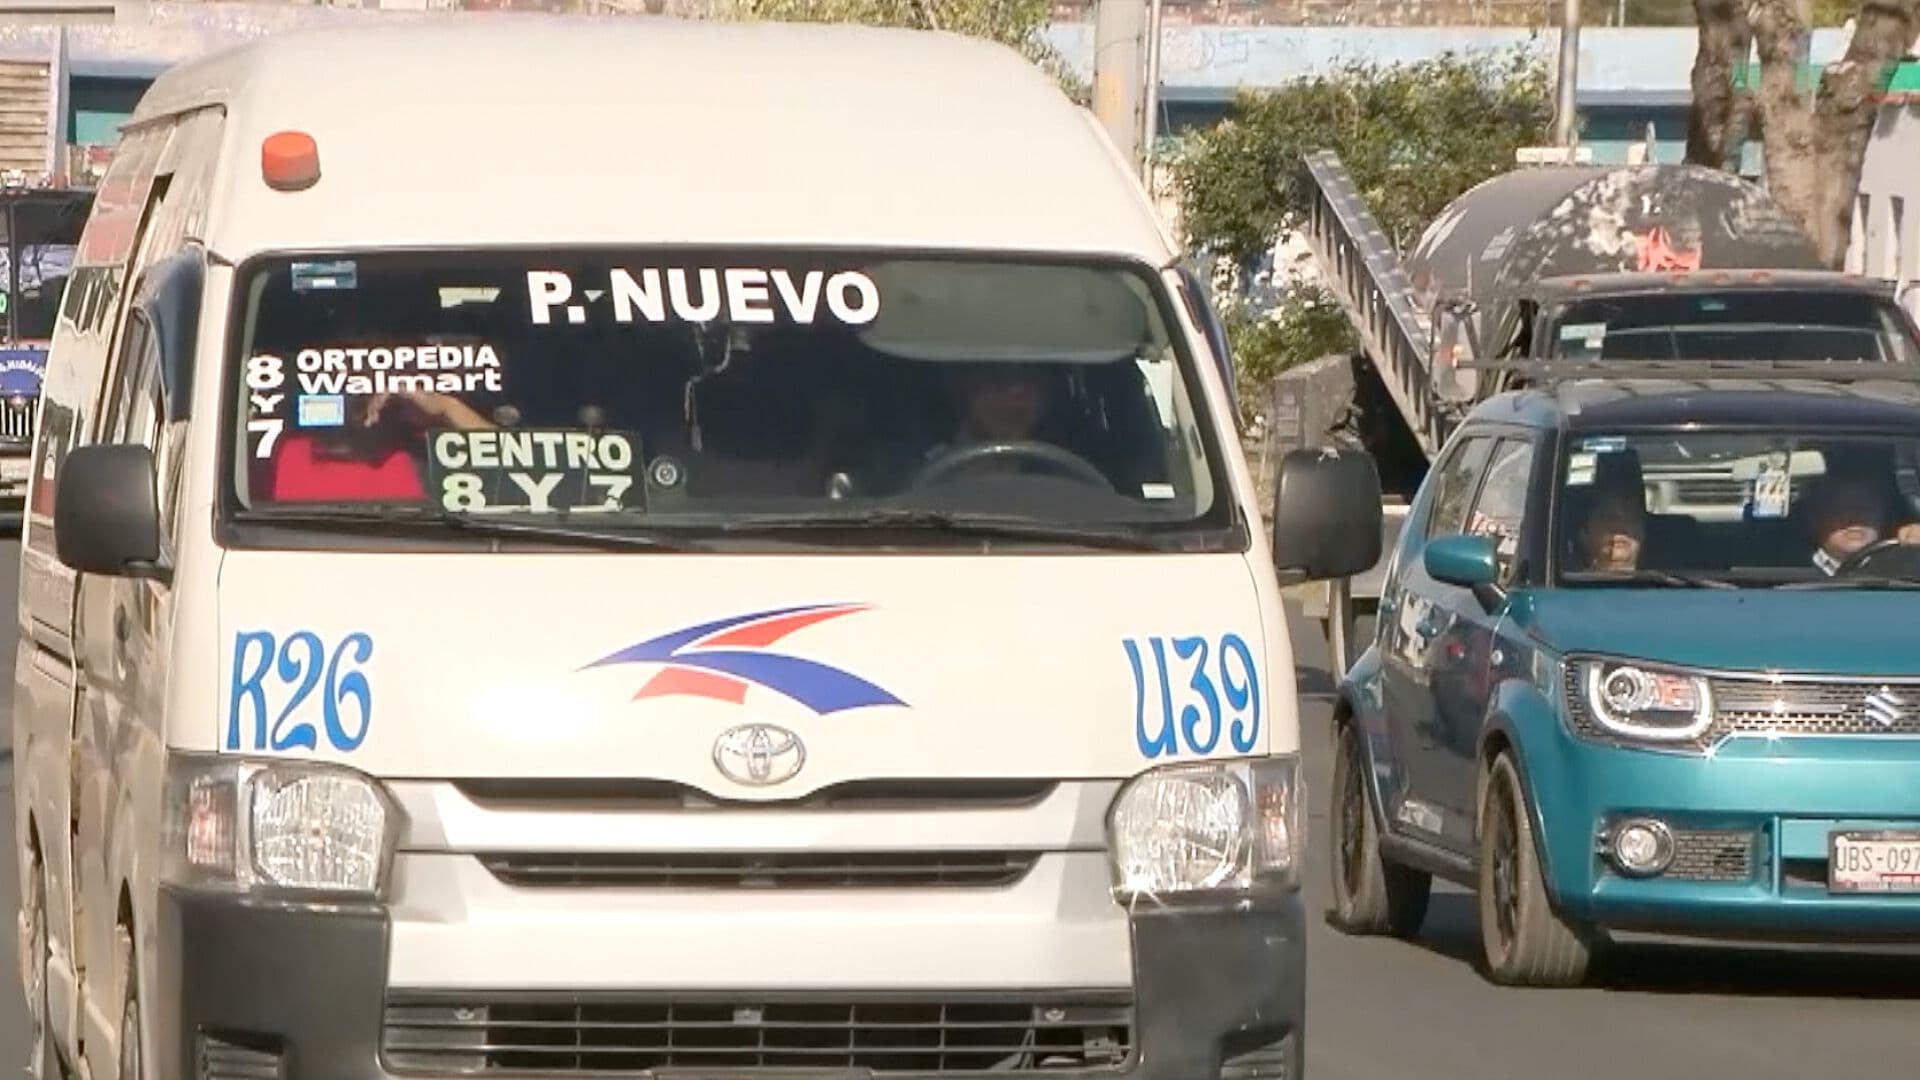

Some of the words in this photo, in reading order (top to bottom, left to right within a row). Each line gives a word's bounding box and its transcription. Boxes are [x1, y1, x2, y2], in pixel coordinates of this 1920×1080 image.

[527, 270, 586, 324] P.
[610, 267, 881, 324] NUEVO
[246, 354, 285, 389] 8
[297, 345, 500, 372] ORTOPEDIA
[298, 368, 502, 394] Walmart
[251, 394, 284, 413] Y
[247, 419, 284, 459] 7
[435, 432, 632, 470] CENTRO
[442, 472, 487, 512] 8
[508, 473, 565, 513] Y
[589, 475, 633, 511] 7
[227, 630, 373, 752] R26
[1121, 633, 1260, 758] U39
